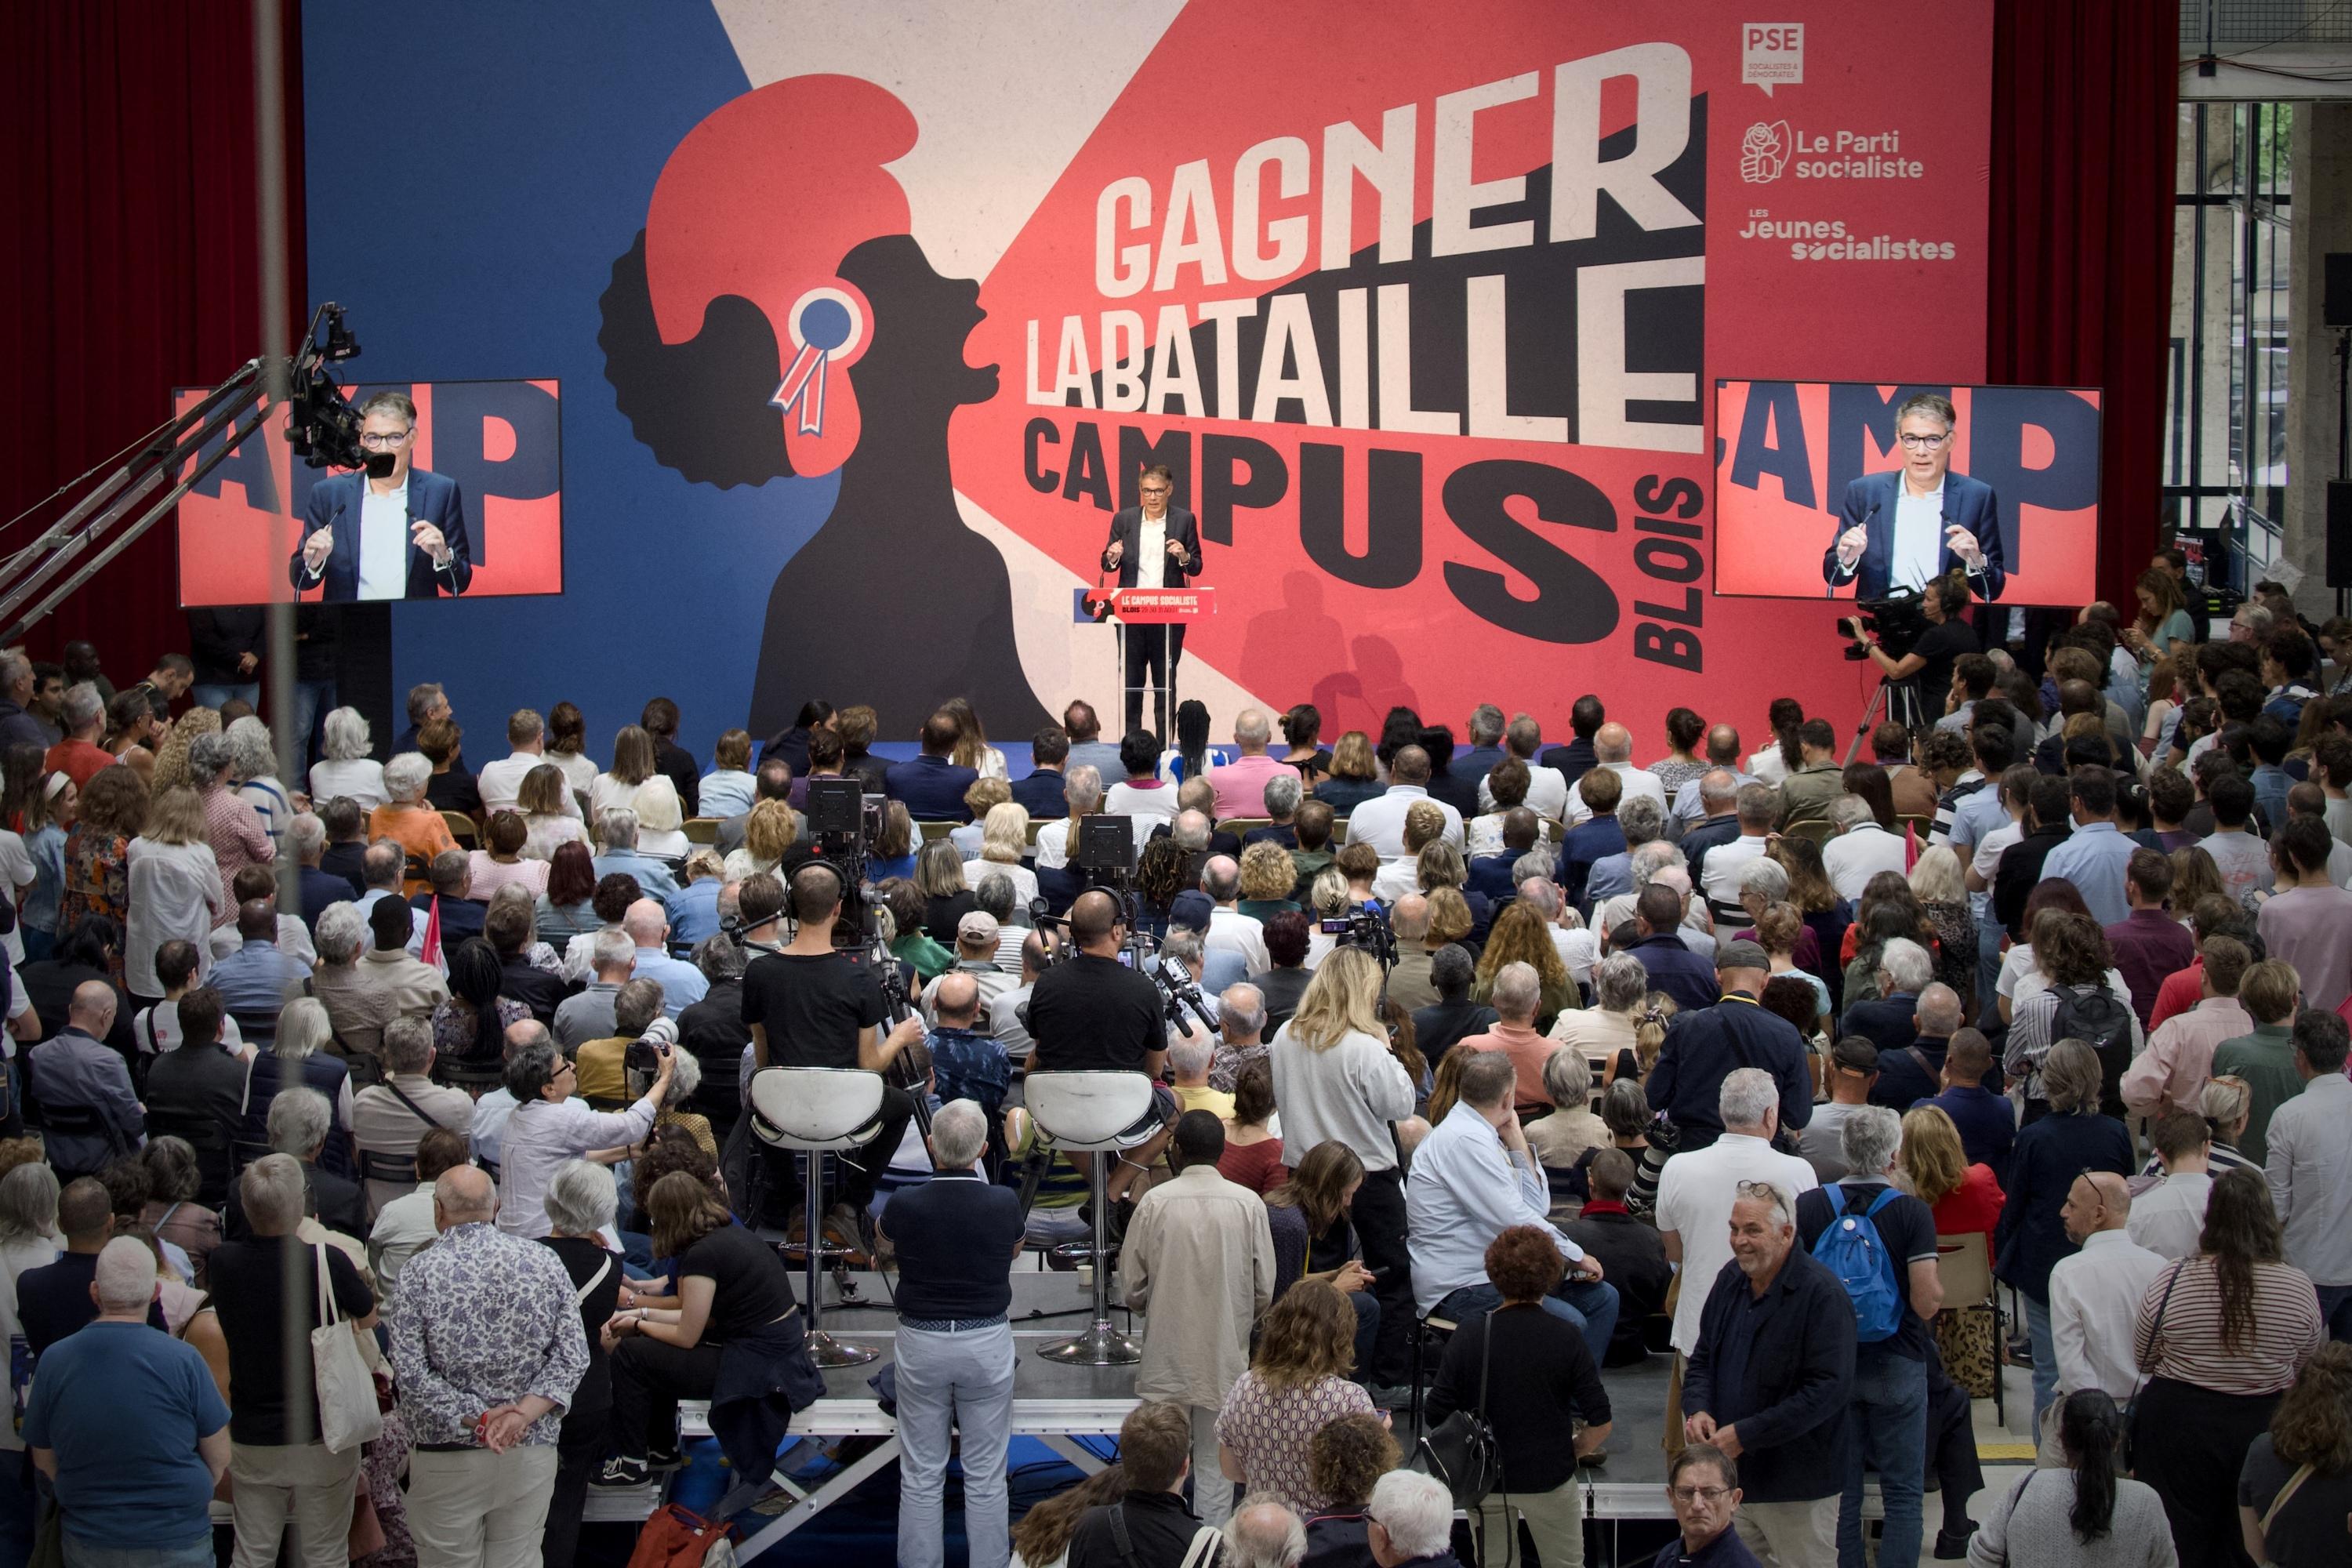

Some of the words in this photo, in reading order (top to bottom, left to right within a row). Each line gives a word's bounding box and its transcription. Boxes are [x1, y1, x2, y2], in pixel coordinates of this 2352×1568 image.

[1748, 28, 1798, 51] PSE
[1797, 131, 1830, 153] Le
[1836, 130, 1900, 153] Parti
[1095, 42, 1704, 298] GAGNER
[1796, 155, 1924, 179] socialiste
[1739, 220, 1846, 239] Jeunes
[1791, 235, 1956, 260] socialistes
[1102, 256, 1705, 454] BATAILLE
[1024, 416, 1619, 644] CAMPUS
[1634, 474, 1704, 673] BLOIS
[1121, 596, 1130, 605] LE
[1131, 596, 1159, 605] CAMPUS
[1160, 596, 1198, 605] SOCIALISTE
